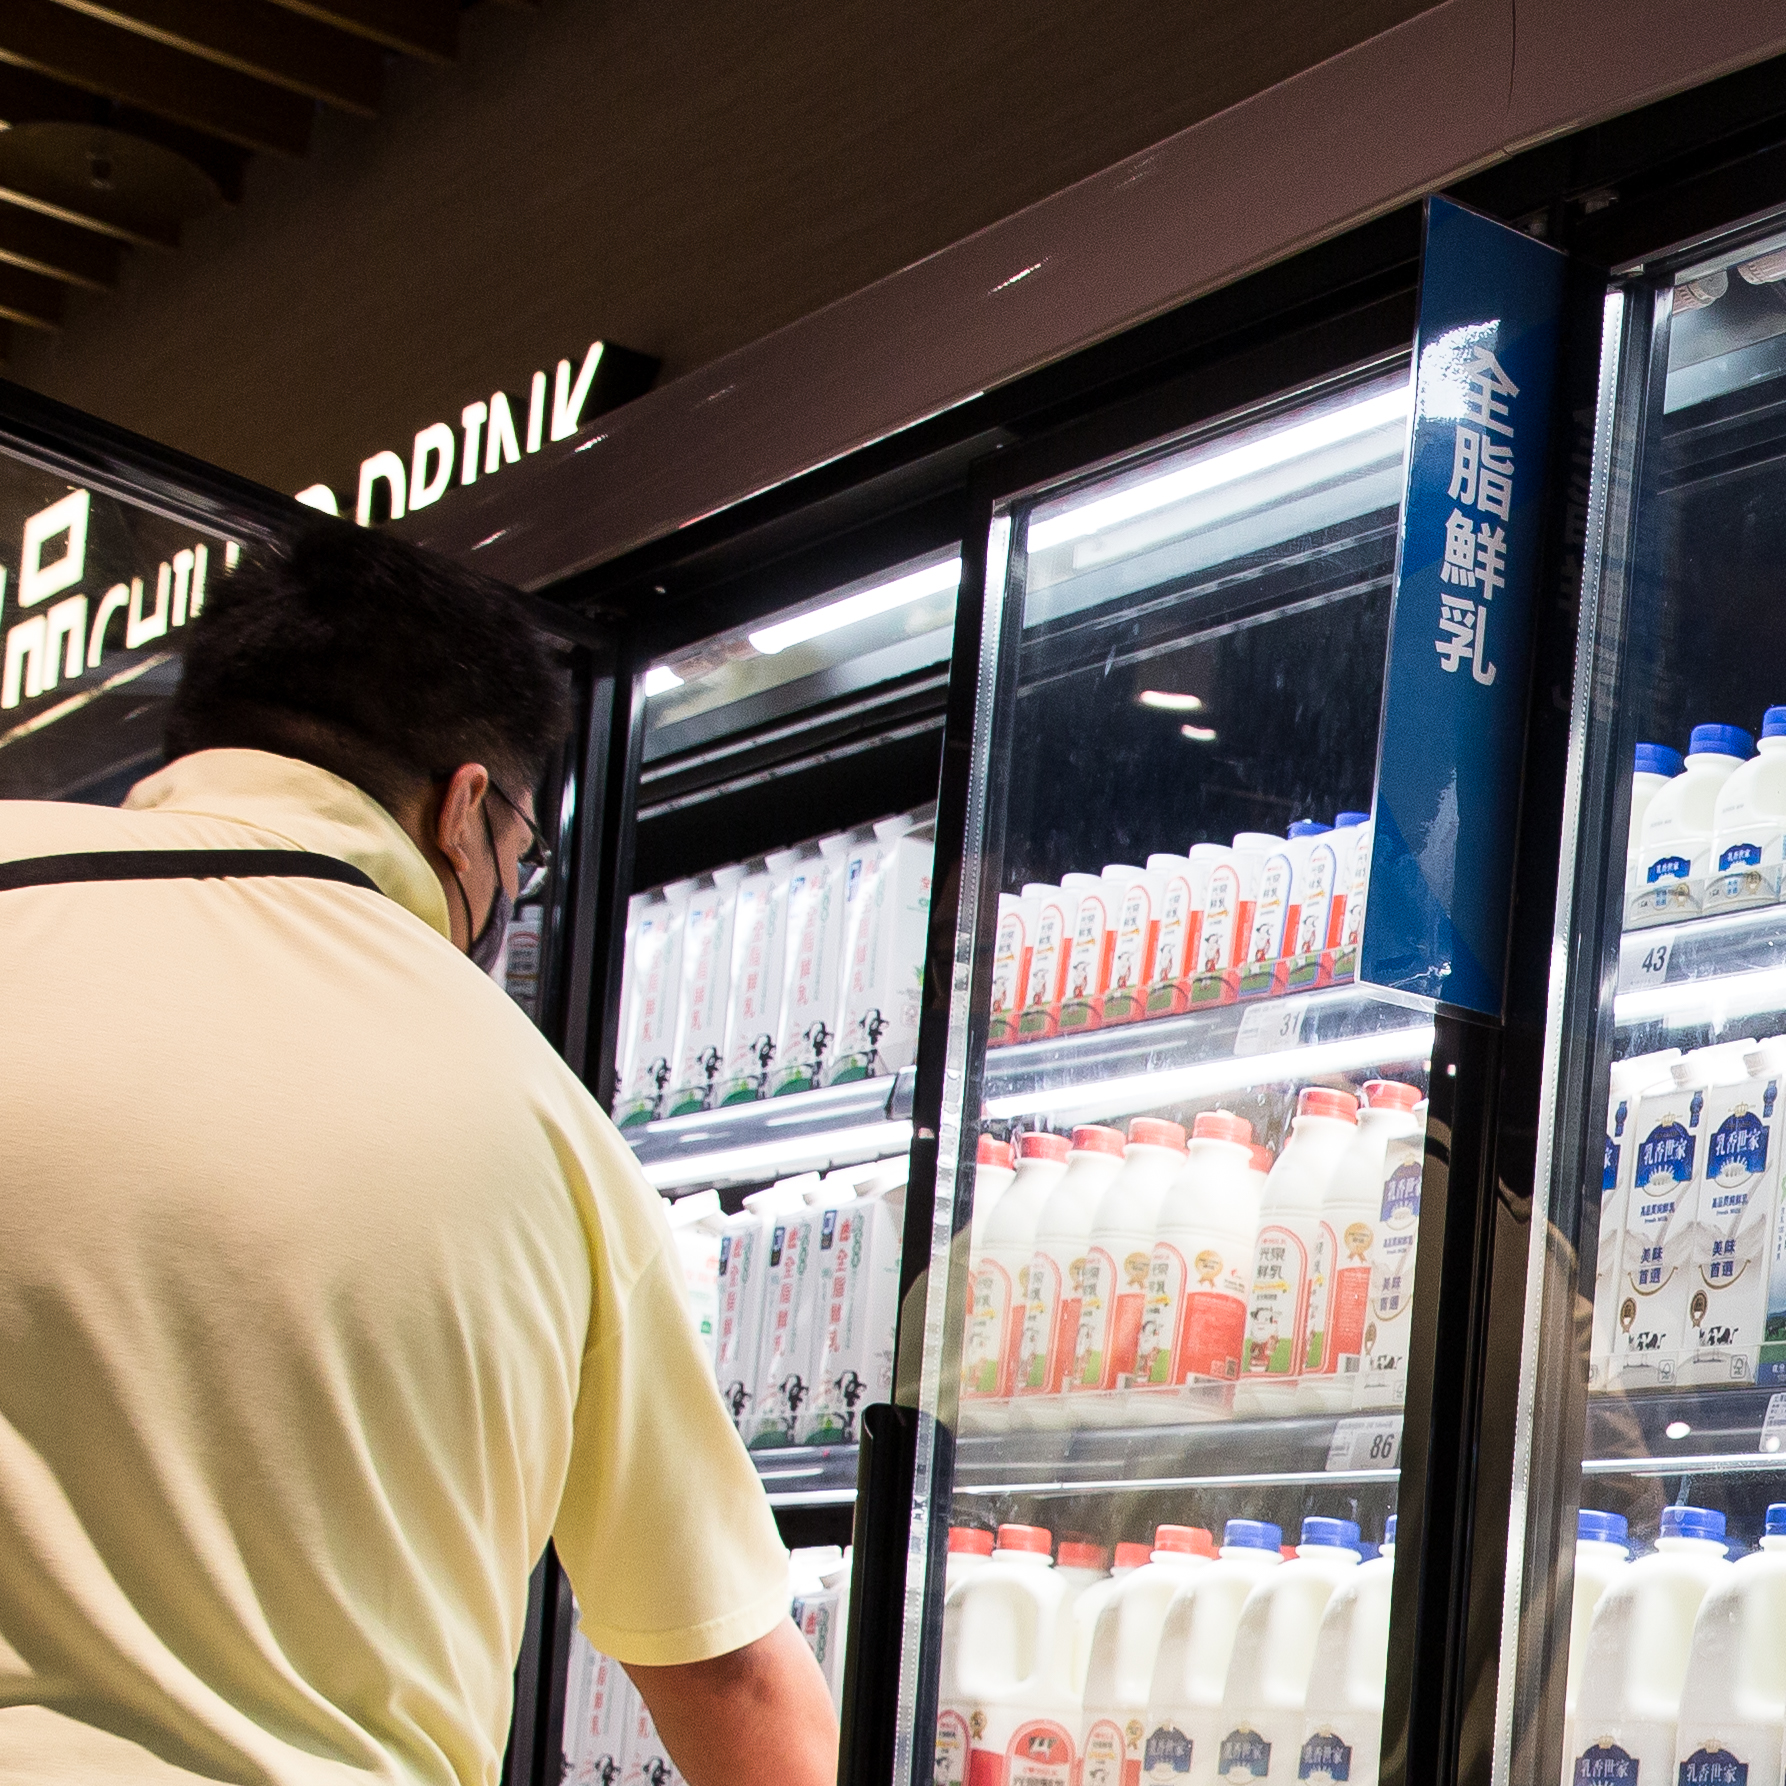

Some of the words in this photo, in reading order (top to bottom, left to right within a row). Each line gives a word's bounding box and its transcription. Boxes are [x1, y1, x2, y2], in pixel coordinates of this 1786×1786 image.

[1435, 346, 1519, 687] 全脂鮮乳
[1642, 946, 1668, 973] 43
[1280, 1012, 1298, 1037] 31
[1644, 1136, 1686, 1165] 乳香世家
[1716, 1127, 1759, 1157] 乳香世家
[1712, 1239, 1735, 1257] 美味
[1710, 1260, 1733, 1278] 首選
[1370, 1434, 1394, 1460] 86
